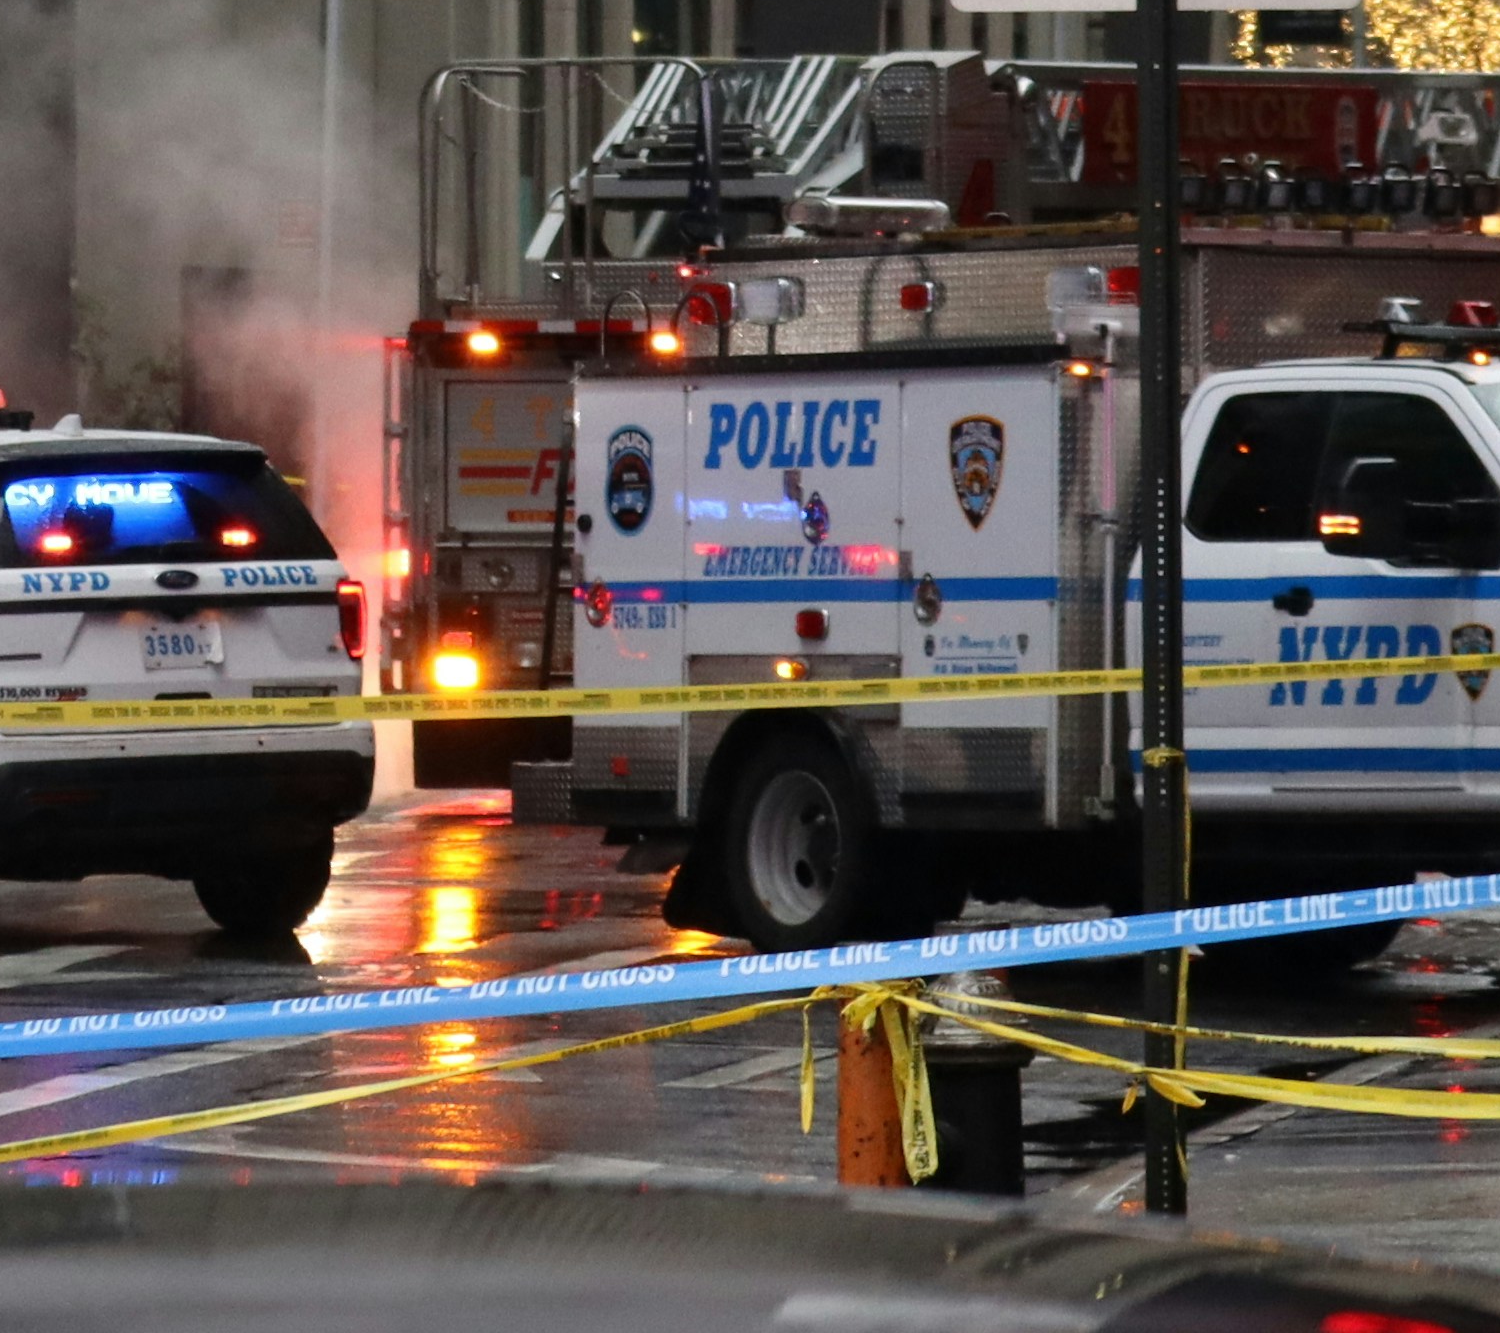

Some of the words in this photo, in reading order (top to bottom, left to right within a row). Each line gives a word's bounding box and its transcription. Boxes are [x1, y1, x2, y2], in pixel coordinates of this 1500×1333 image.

[704, 399, 882, 470] POLICE
[704, 546, 804, 577] EMERGENCY
[21, 571, 110, 594] NYPD
[221, 564, 318, 588] POLICE
[145, 634, 196, 657] 3580
[1268, 623, 1442, 707] NYPD
[1174, 902, 1274, 933] POLICE
[1284, 893, 1346, 923] LINE
[829, 942, 892, 966] LINE
